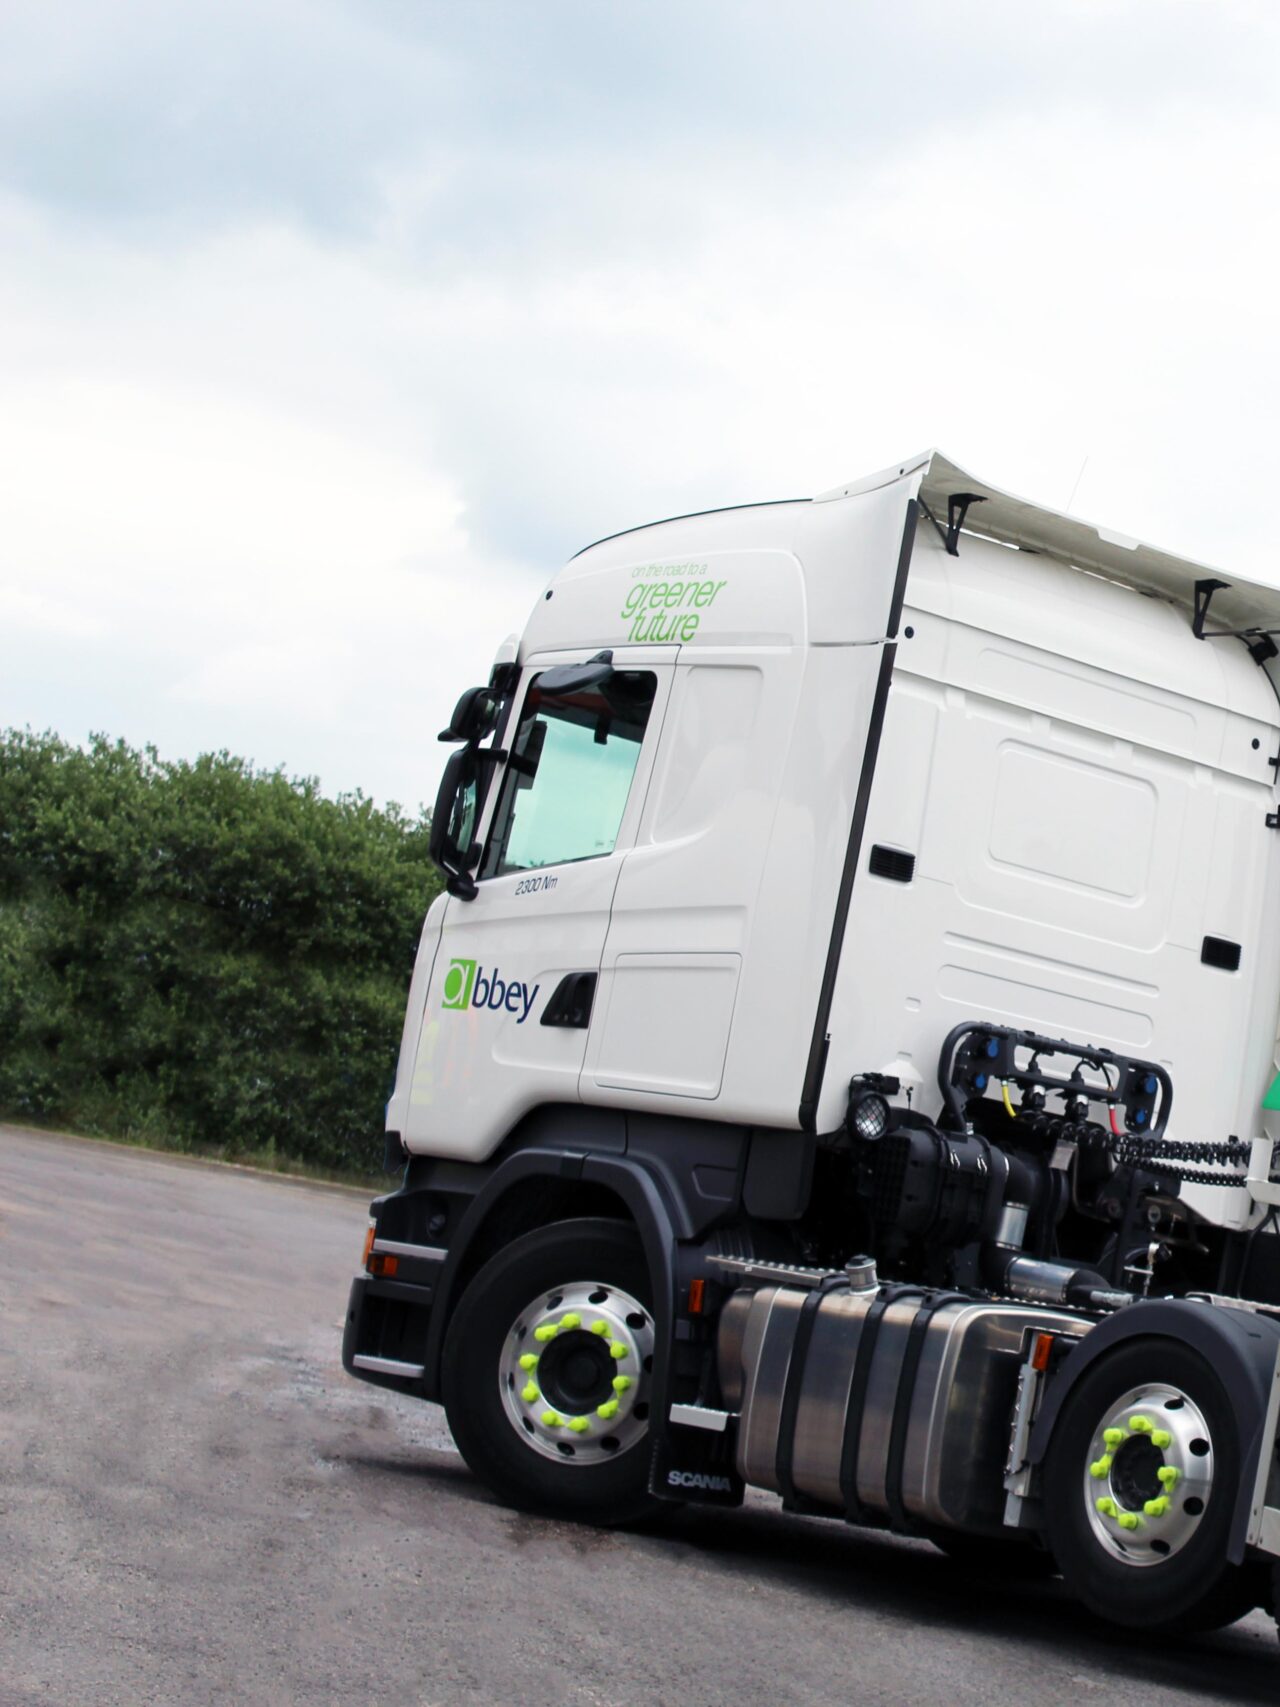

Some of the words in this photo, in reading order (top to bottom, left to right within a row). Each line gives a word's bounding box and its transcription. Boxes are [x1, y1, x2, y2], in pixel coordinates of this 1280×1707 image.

[631, 566, 646, 578] on
[645, 562, 663, 577] the
[662, 562, 689, 577] road
[698, 563, 708, 575] a
[620, 580, 728, 620] greener
[627, 606, 700, 642] future
[515, 877, 543, 896] 2300
[541, 875, 558, 891] Nm
[441, 958, 540, 1025] abbey
[667, 1470, 732, 1493] SCANIA
